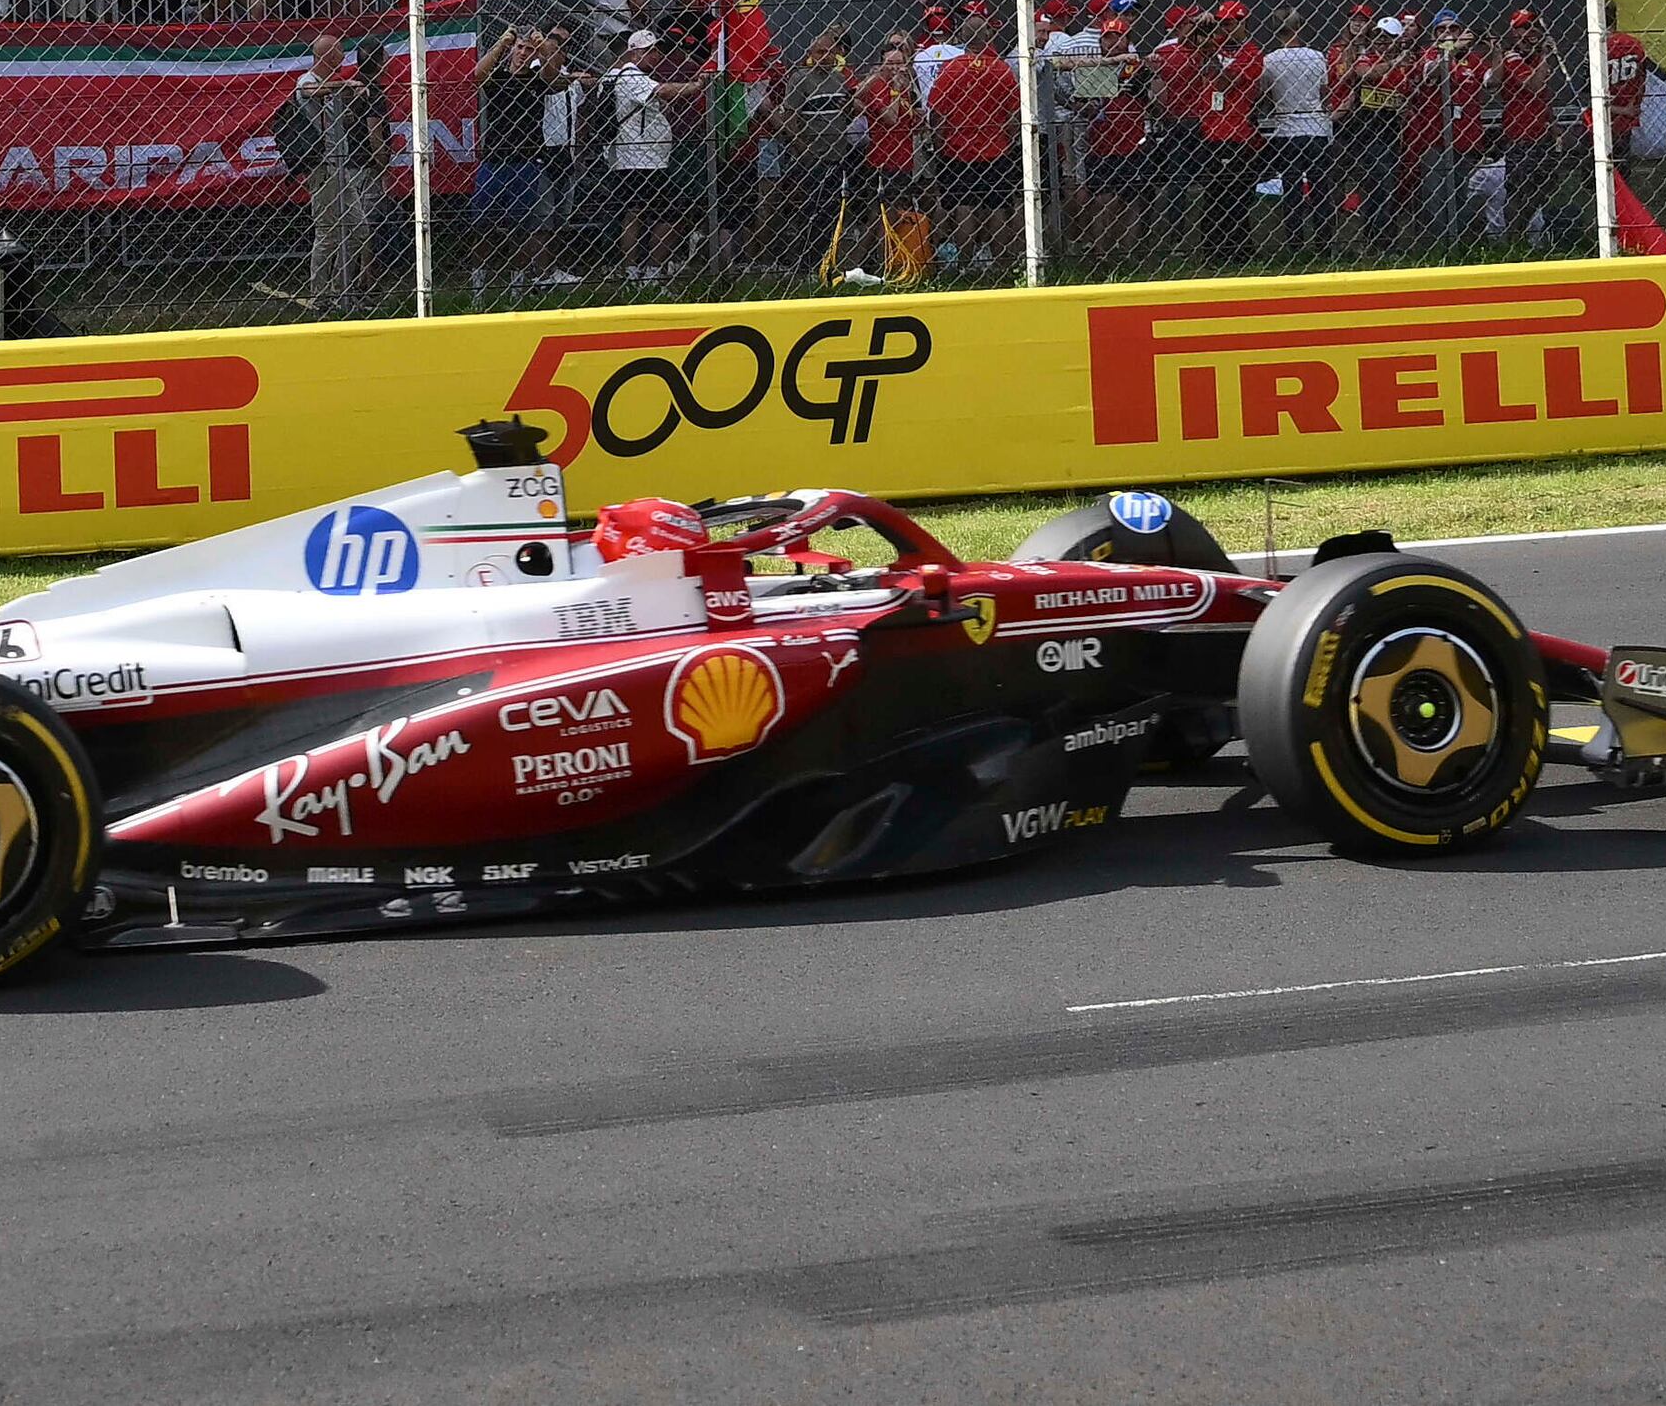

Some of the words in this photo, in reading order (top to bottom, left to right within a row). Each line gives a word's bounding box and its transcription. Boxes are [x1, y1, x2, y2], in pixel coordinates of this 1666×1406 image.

[1088, 279, 1666, 445] PIRELLI
[508, 476, 558, 499] ZCG
[1118, 492, 1163, 528] hp
[323, 510, 410, 593] hp
[706, 590, 751, 609] aws
[1035, 586, 1128, 610] RICHARD
[1133, 582, 1196, 602] MILLE
[553, 596, 639, 638] IBM
[511, 741, 632, 784] PERONI
[181, 860, 269, 884] brembo
[306, 866, 375, 884] MAHLE
[404, 866, 455, 884] NGK
[482, 862, 539, 881] SKF
